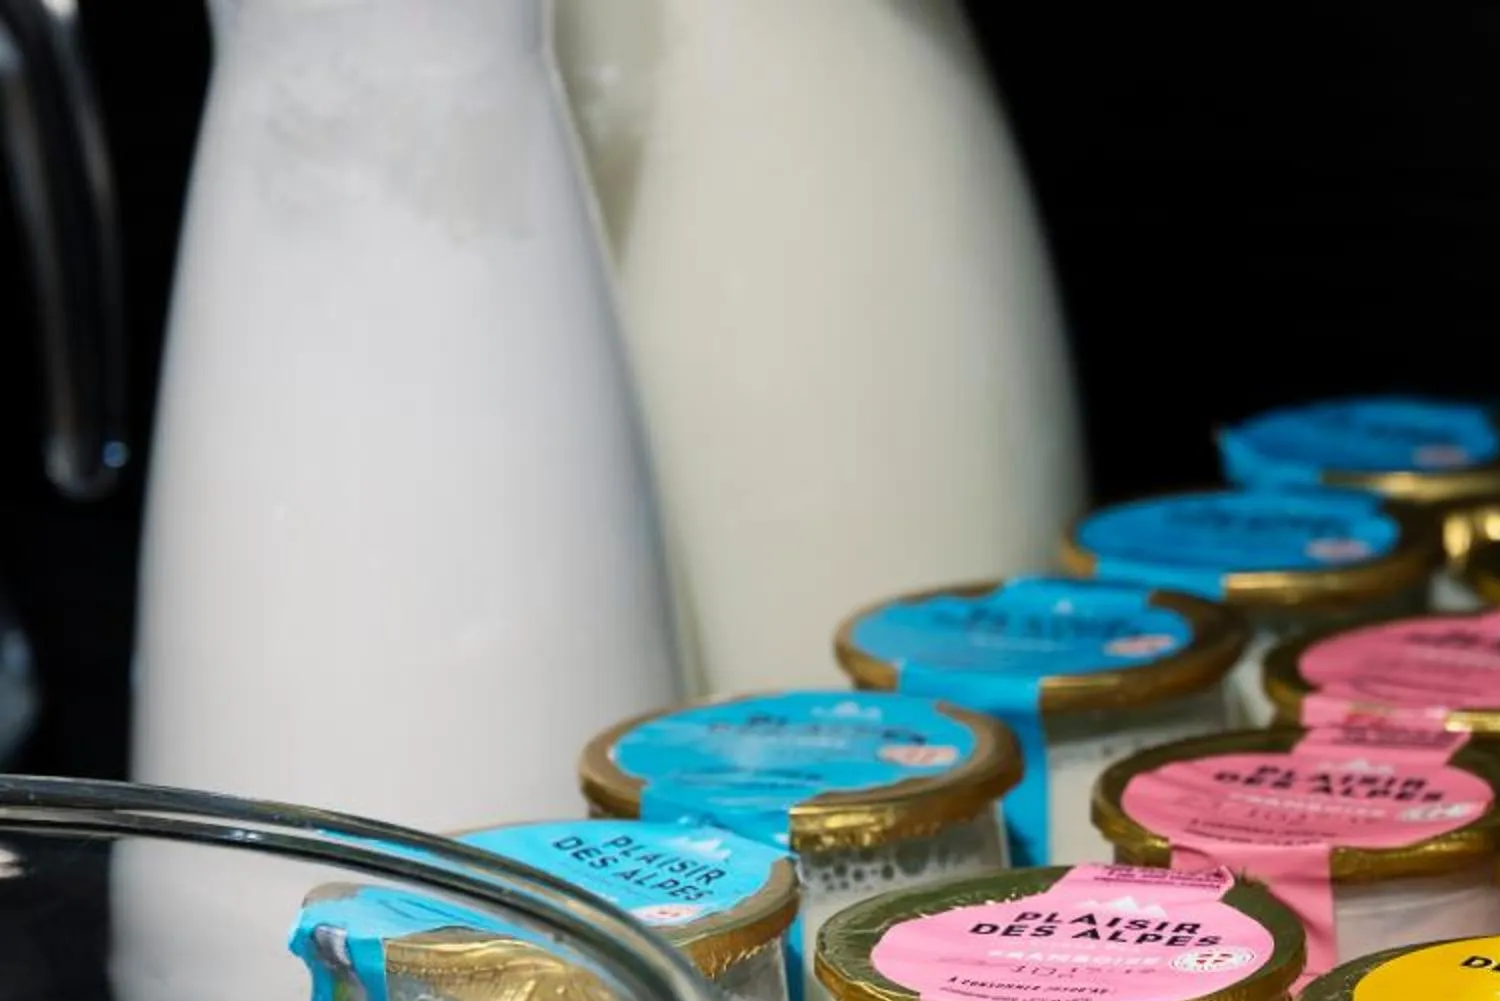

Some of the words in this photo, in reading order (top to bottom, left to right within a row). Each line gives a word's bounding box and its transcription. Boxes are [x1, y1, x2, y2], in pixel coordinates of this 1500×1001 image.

[552, 835, 616, 869] DES
[613, 865, 715, 903] ALPES
[603, 834, 729, 886] PLAISIR
[970, 923, 1057, 937] DES
[1071, 927, 1223, 947] ALPES
[1014, 911, 1201, 935] PLAISIR
